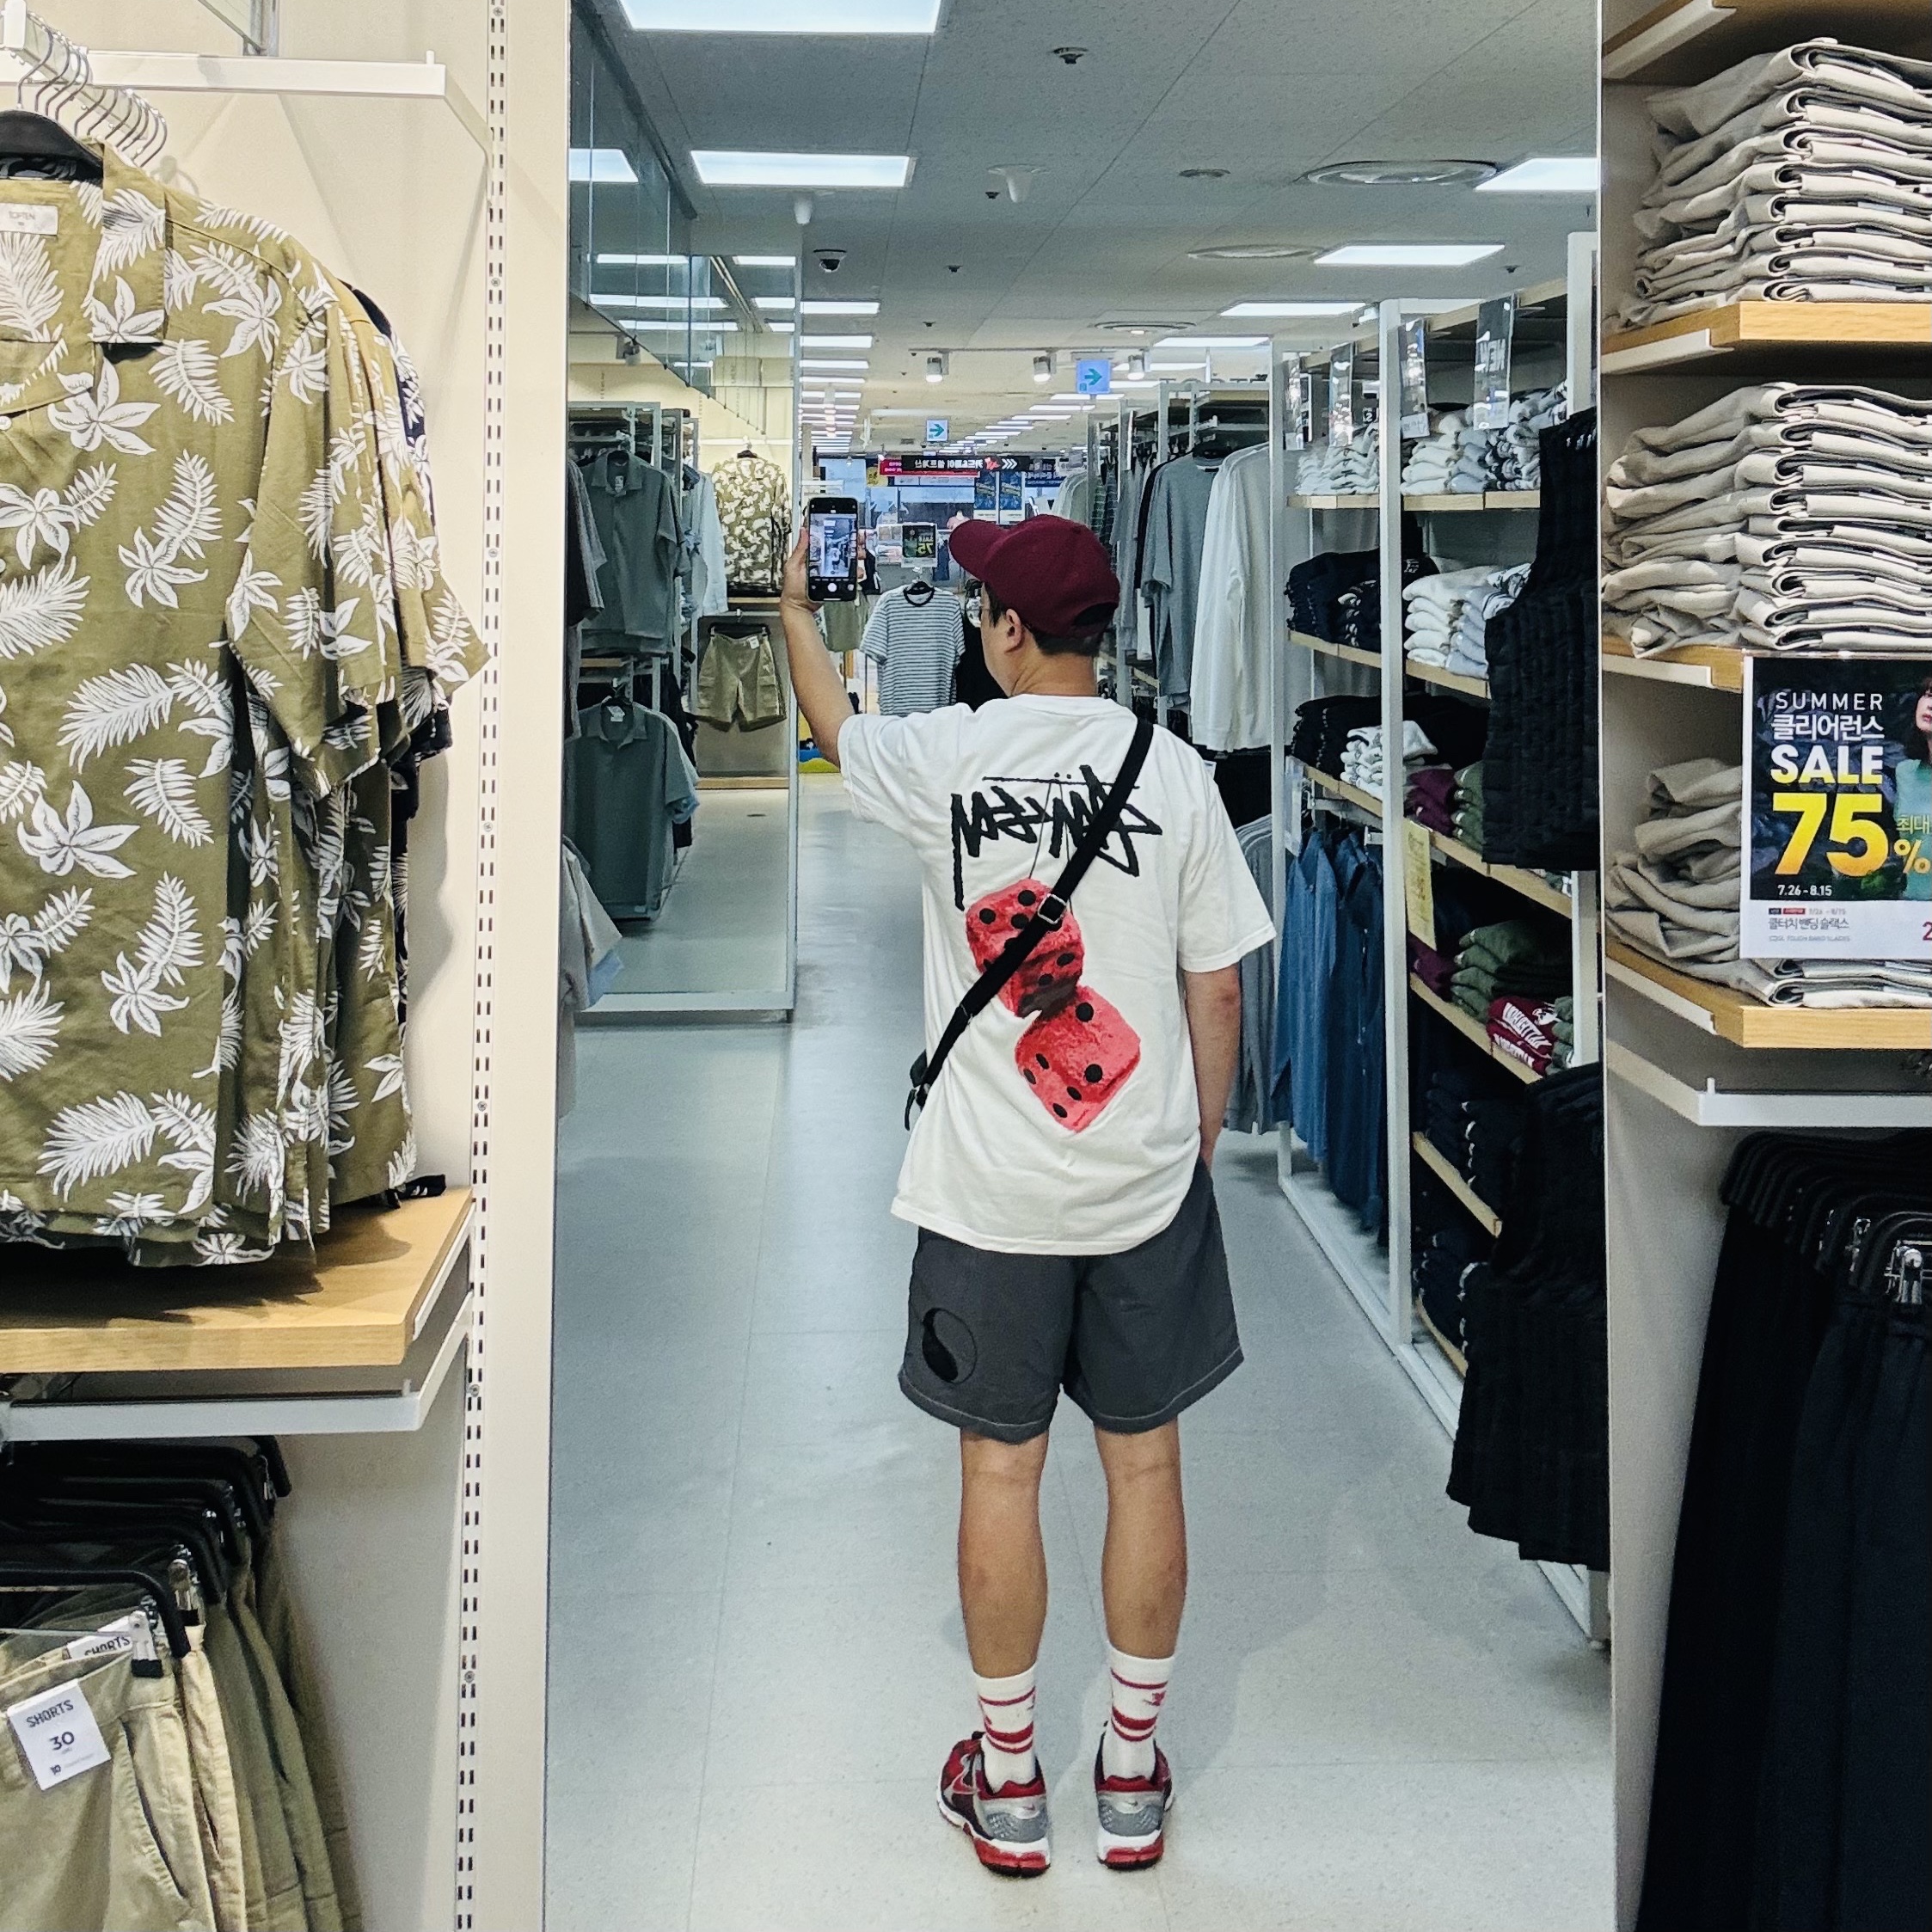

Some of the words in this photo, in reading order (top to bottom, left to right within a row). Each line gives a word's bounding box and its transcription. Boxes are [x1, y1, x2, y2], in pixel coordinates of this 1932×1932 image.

[1776, 691, 1883, 711] SUMMER
[1770, 714, 1886, 741] 클리어런스
[1770, 744, 1885, 784] SALE
[1895, 814, 1930, 835] 최대
[26, 1699, 74, 1728] SHORTS
[49, 1731, 75, 1751] 30
